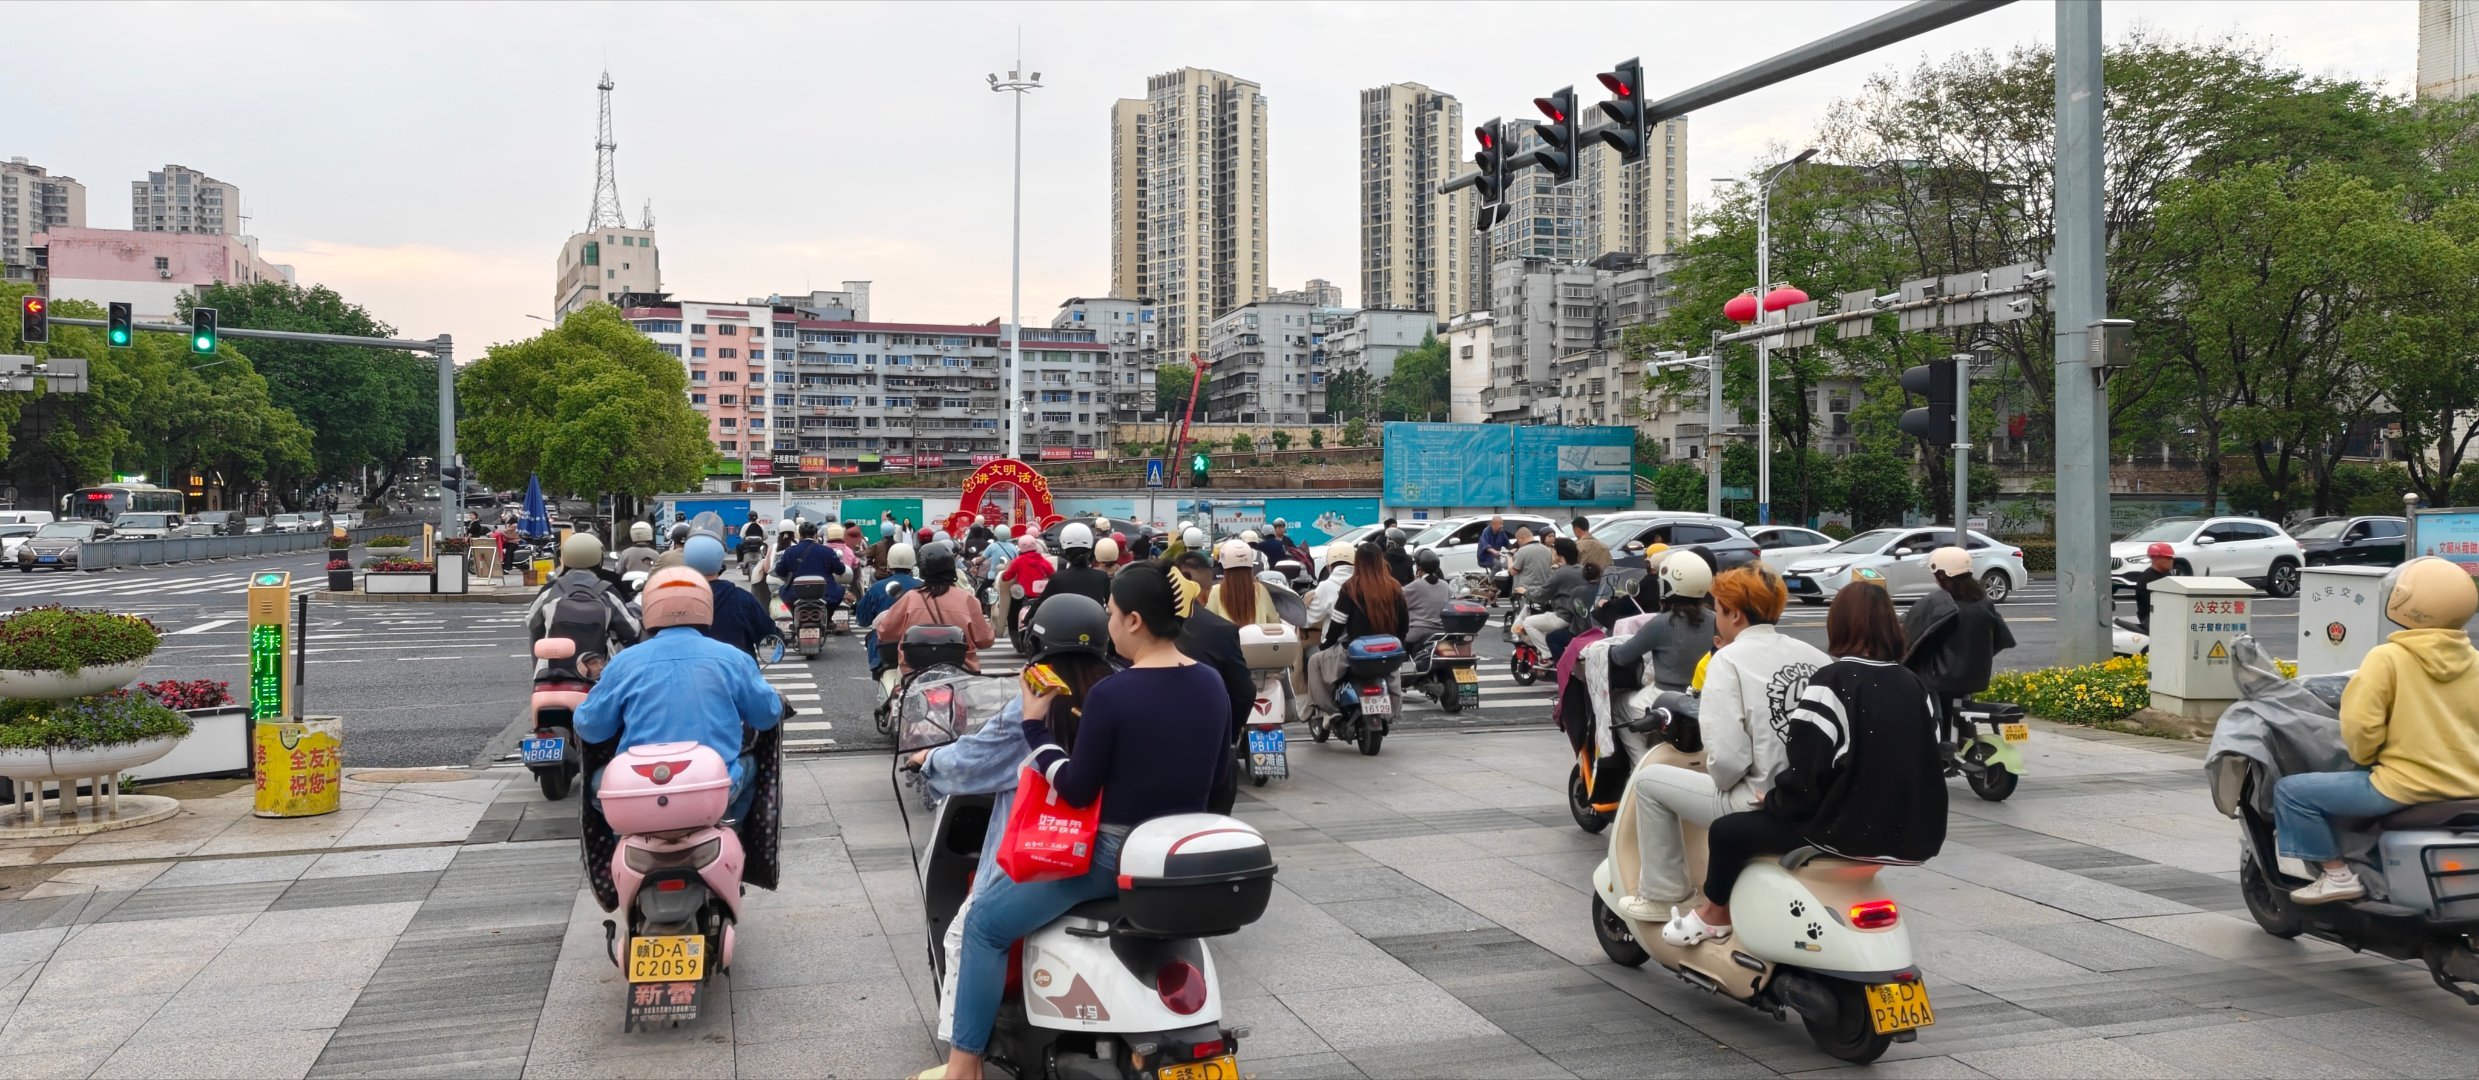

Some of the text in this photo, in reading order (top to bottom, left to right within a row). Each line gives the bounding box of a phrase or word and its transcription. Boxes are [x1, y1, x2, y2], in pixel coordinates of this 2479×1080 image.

[975, 464, 1031, 485] 讲文明话
[2312, 586, 2365, 606] 公安交警
[2194, 600, 2246, 614] 公安交警
[1364, 704, 1391, 713] 16129
[1251, 741, 1283, 752] PB118
[524, 749, 560, 761] NB048
[636, 960, 697, 976] C2059
[1875, 1002, 1932, 1031] P346A
